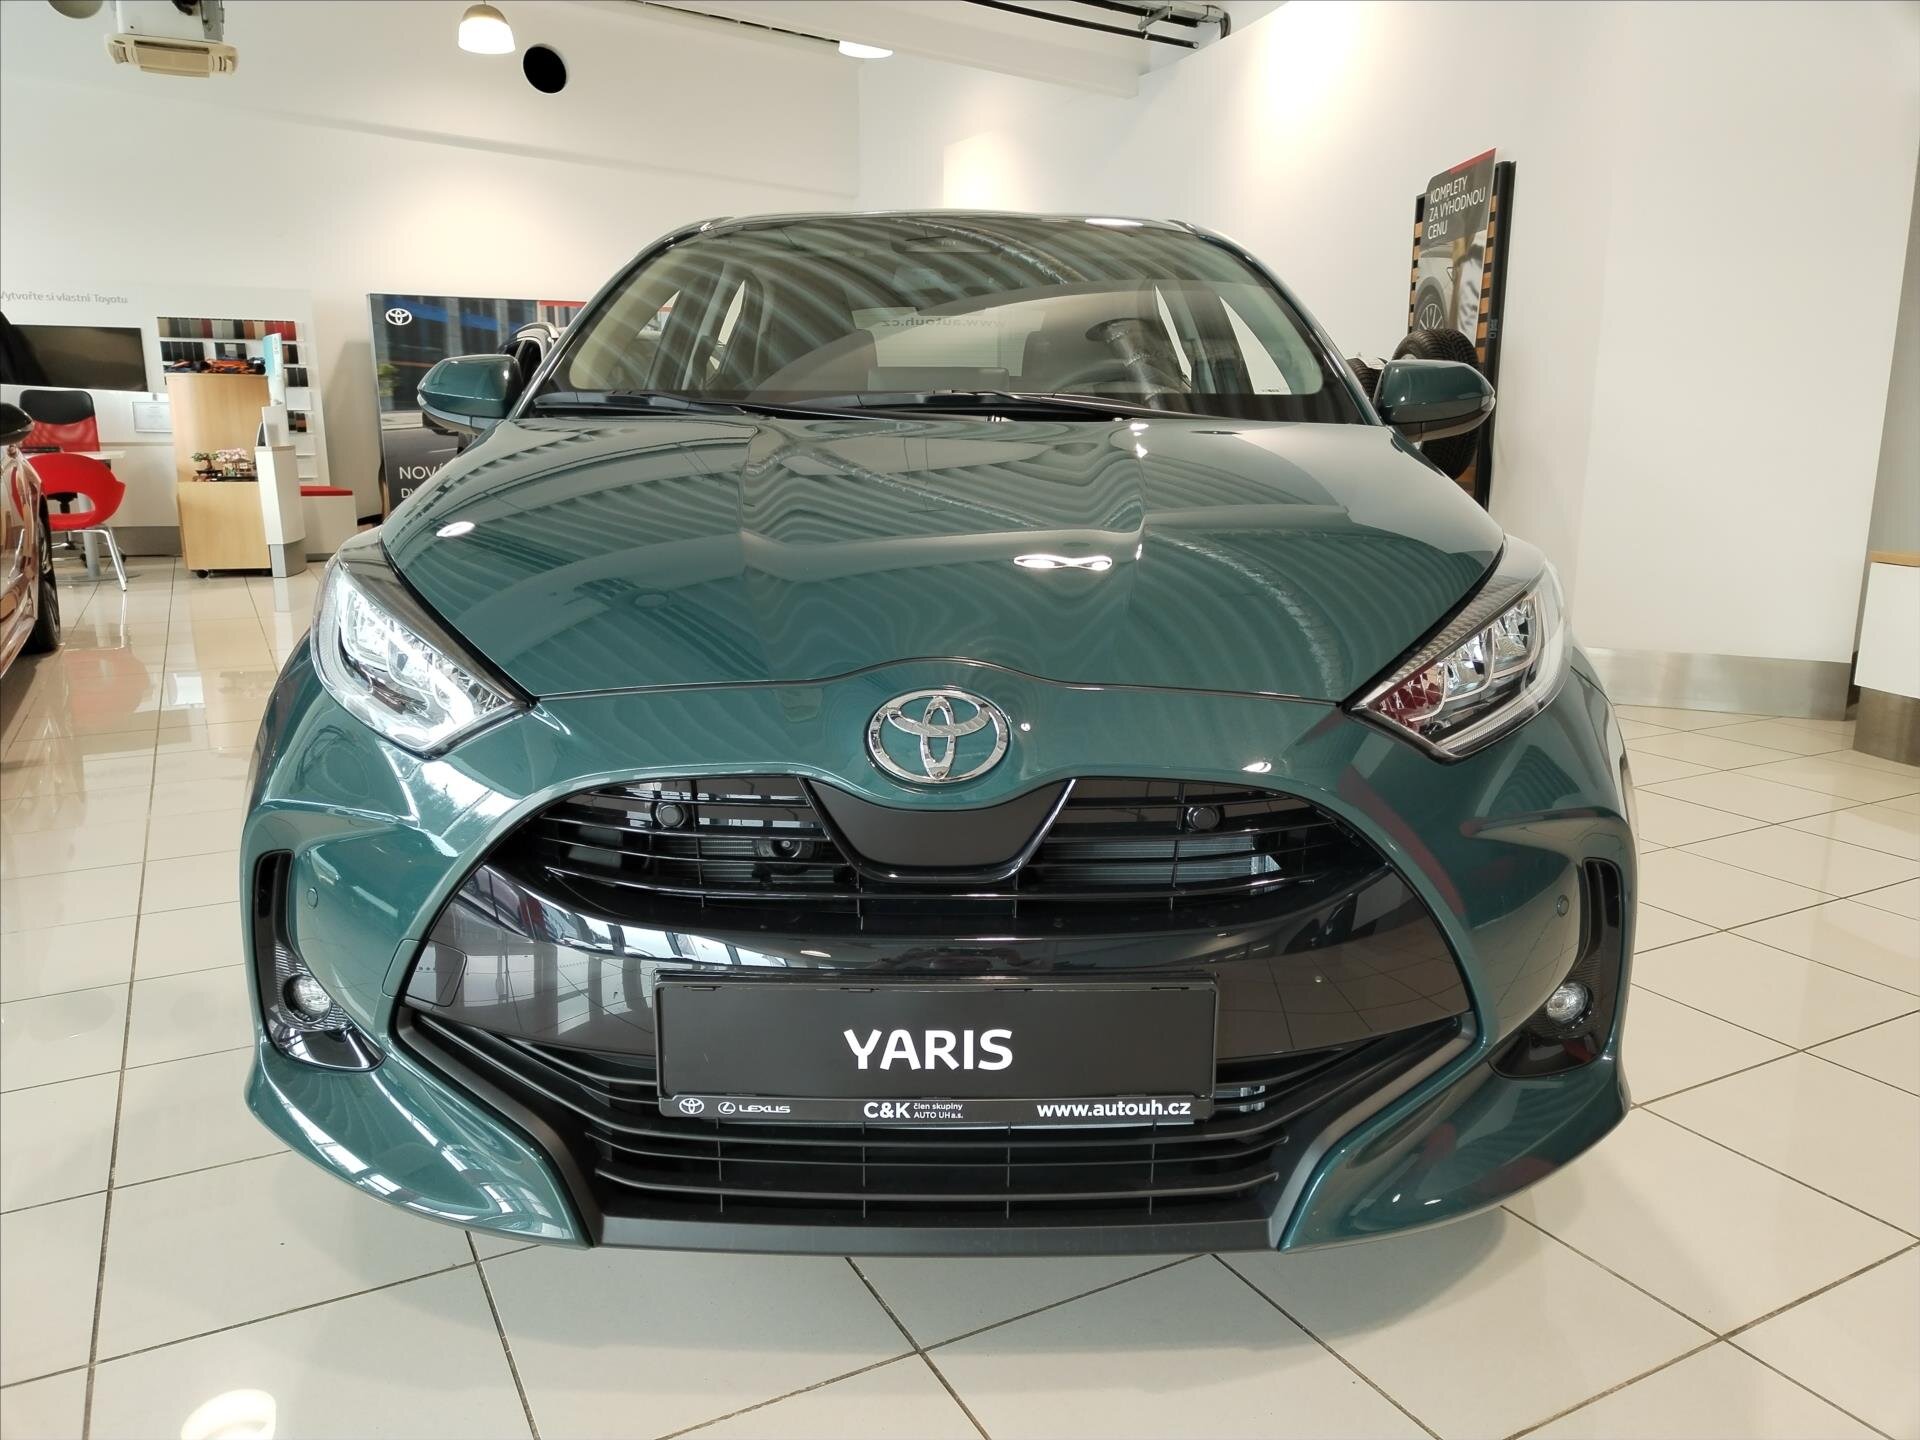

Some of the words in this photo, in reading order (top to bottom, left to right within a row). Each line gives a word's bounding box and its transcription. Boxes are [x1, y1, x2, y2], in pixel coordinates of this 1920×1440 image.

[1430, 176, 1467, 204] KOMPLETY
[1429, 206, 1439, 222] ZA
[1428, 220, 1448, 240] CENU
[94, 294, 128, 305] Toyotu
[843, 1029, 1013, 1070] YARIS
[739, 1104, 791, 1114] LEXUS
[863, 1102, 911, 1119] C&K
[913, 1102, 930, 1110] člen
[932, 1102, 963, 1111] skupiny
[1036, 1099, 1191, 1117] www.autouh.cz
[913, 1111, 937, 1119] AUTO
